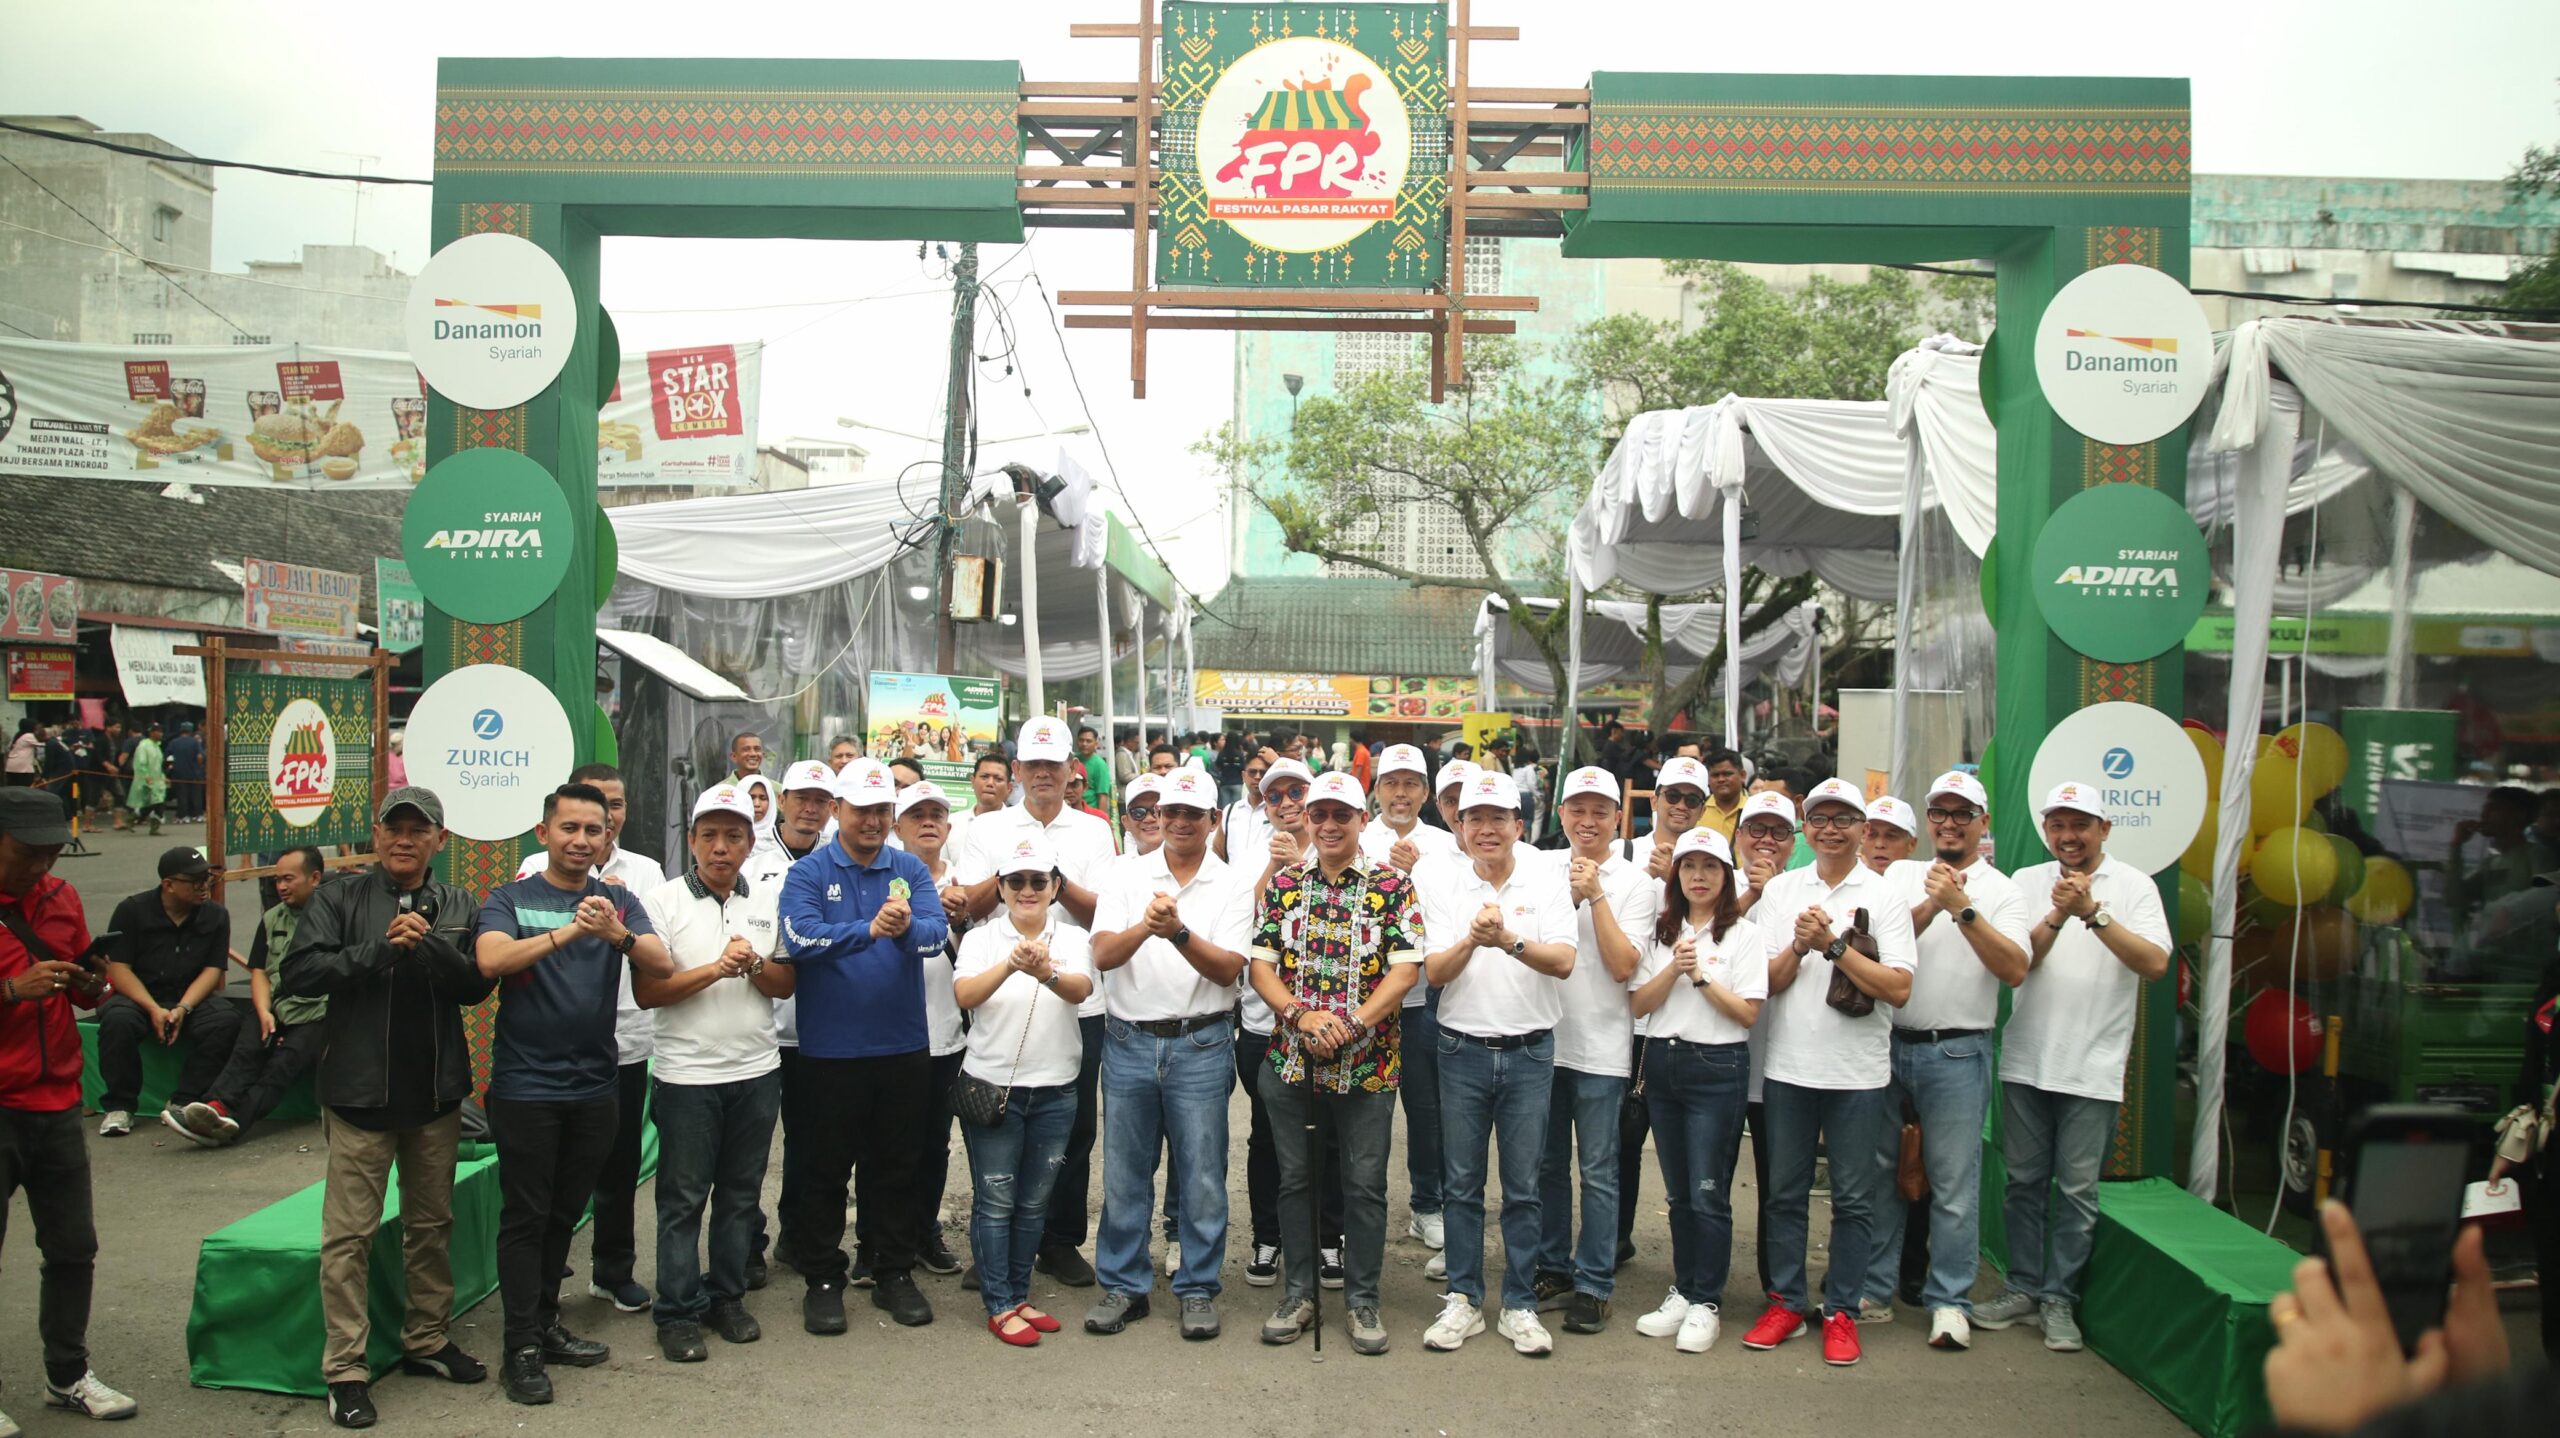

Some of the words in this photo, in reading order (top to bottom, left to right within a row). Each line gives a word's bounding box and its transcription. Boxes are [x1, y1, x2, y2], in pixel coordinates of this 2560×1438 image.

[1240, 141, 1362, 193] FPR
[1214, 203, 1281, 215] FESTIVAL
[1282, 204, 1330, 215] PASAR
[1331, 204, 1389, 215] RAKYAT
[434, 319, 542, 340] Danamon
[489, 346, 542, 362] Syariah
[682, 355, 704, 365] NEW
[2066, 350, 2178, 372] Danamon
[662, 362, 730, 396] STAR
[2122, 379, 2178, 396] Syariah
[32, 420, 72, 431] KUNJUNGI
[675, 420, 724, 431] COMBOS
[30, 434, 60, 444] MEDAN
[62, 435, 84, 445] MALL
[17, 445, 57, 456] THAMRIN
[58, 447, 84, 457] PLAZA
[22, 457, 63, 468] BERSAMA
[64, 459, 109, 470] RINGROAD
[484, 512, 542, 523] SYARIAH
[424, 529, 543, 549] ADIRA
[451, 550, 543, 559] FINANCE
[2117, 549, 2179, 561] SYARIAH
[285, 568, 313, 593] JAYA
[317, 573, 350, 598] ABADI
[2054, 566, 2179, 586] ADIRA
[2082, 587, 2180, 597] FINANCE
[1220, 678, 1335, 693] VIRAL
[1289, 699, 1350, 708] LUBIS
[475, 713, 499, 736] Z
[446, 749, 529, 767] ZURICH
[283, 760, 324, 791] FPR
[459, 770, 520, 789] Syariah
[2102, 789, 2161, 807] RICH
